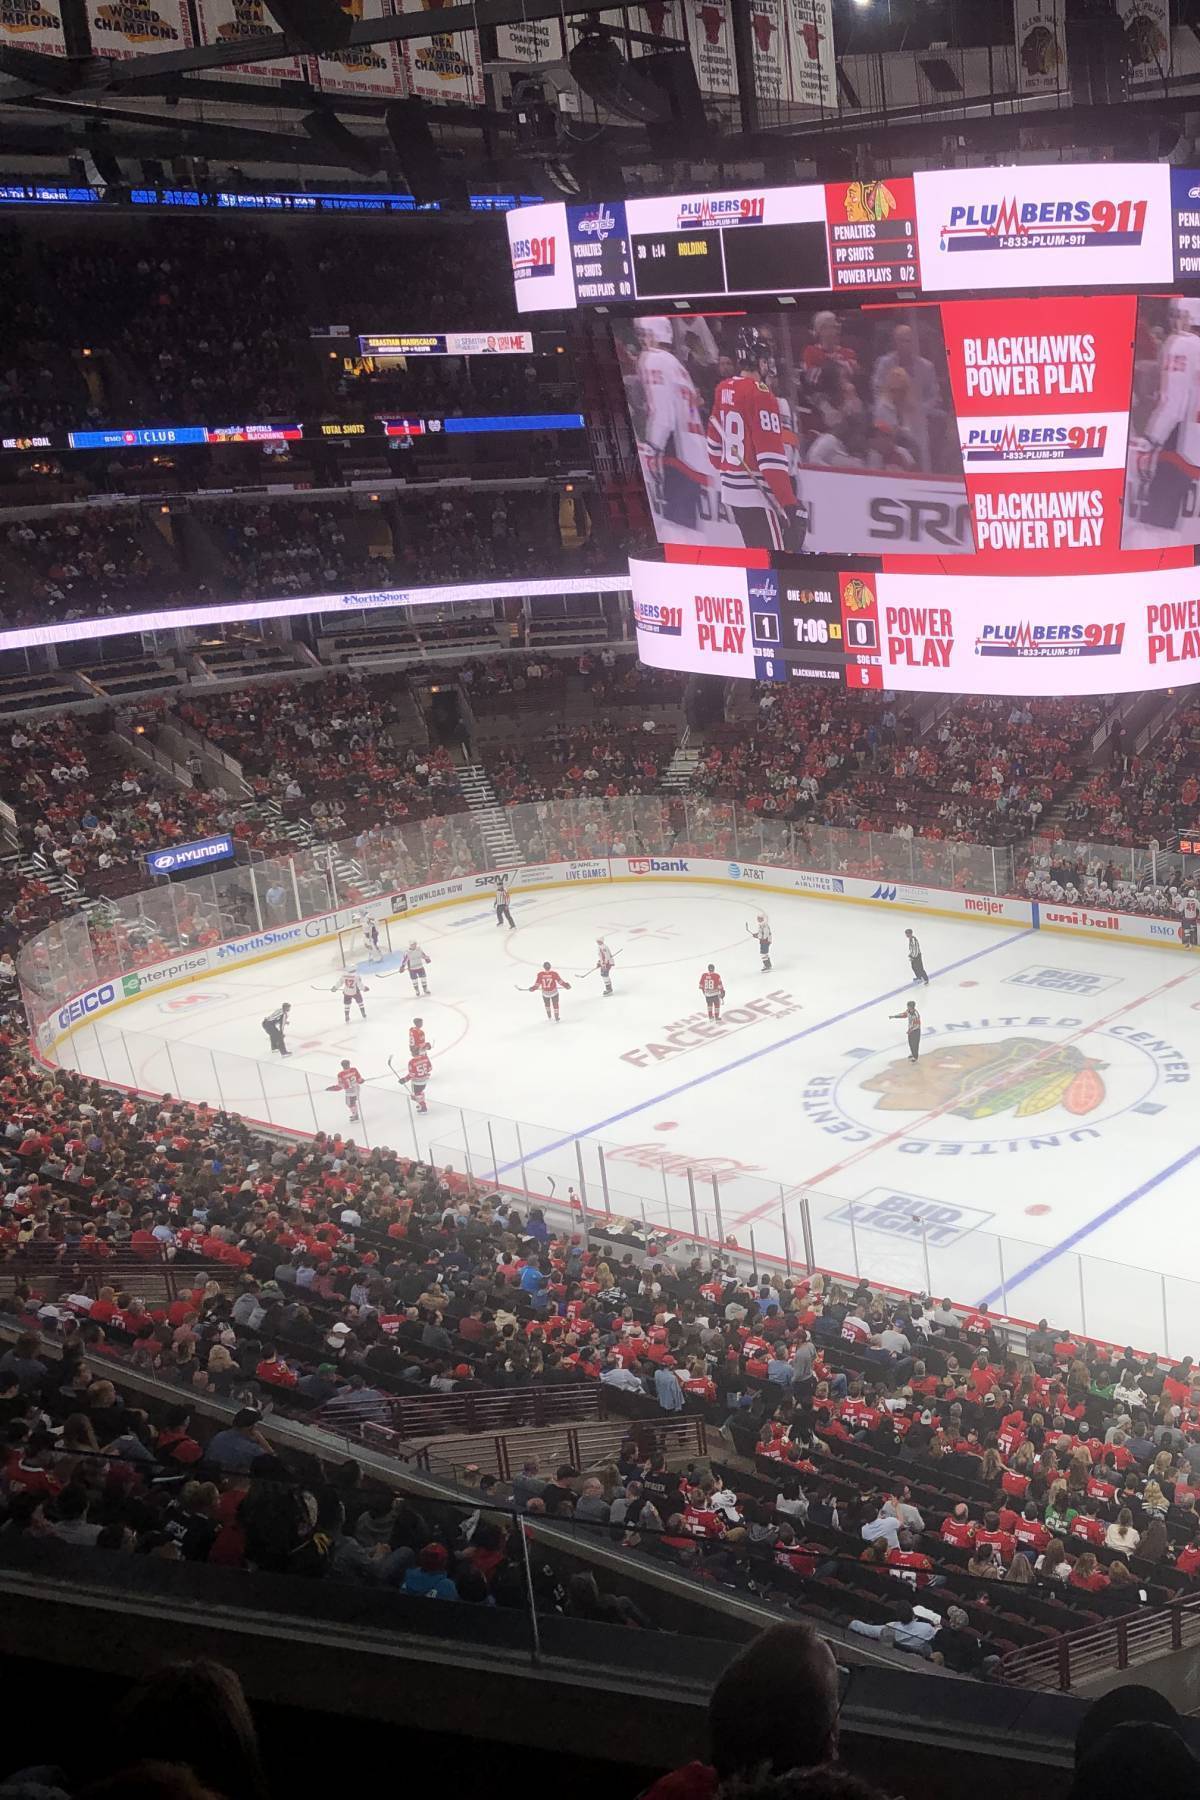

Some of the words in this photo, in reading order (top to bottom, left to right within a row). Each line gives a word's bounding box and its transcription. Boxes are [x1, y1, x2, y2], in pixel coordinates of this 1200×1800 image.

[94, 18, 179, 41] CHAMPIONS
[740, 197, 765, 217] 911
[949, 196, 1092, 235] PLUMBERS
[1091, 199, 1148, 232] 911
[834, 224, 876, 240] PENALTIES
[905, 221, 911, 236] 0
[531, 236, 555, 266] 911
[574, 244, 602, 257] PENALTIES
[621, 242, 626, 254] 2
[678, 241, 707, 256] HOLDING
[998, 235, 1086, 249] 1-833-PLUM-911
[1179, 236, 1190, 249] PP
[836, 248, 847, 262] PP
[848, 247, 874, 261] SHOTS
[907, 244, 913, 258] 2
[576, 266, 583, 277] PP
[584, 264, 602, 277] SHOTS
[623, 263, 628, 275] 0
[838, 269, 867, 284] POWER
[868, 267, 891, 282] PLAYS
[900, 267, 914, 281] 0/2
[578, 284, 597, 297] POWER
[597, 283, 615, 296] PLAYS
[964, 335, 1096, 366] BLACKHAWKS
[966, 363, 1041, 397] POWER
[1044, 363, 1096, 394] PLAY
[322, 425, 342, 434] TOTAL
[343, 424, 365, 434] SHOTS
[759, 410, 782, 433] 88
[2, 439, 16, 448] ONE
[32, 438, 51, 447] GOAL
[144, 431, 176, 442] CLUB
[968, 424, 1068, 450] PLUMBERS
[1068, 425, 1108, 448] 911
[1002, 450, 1065, 460] 1-833-PLUM-911
[975, 490, 1104, 521] BLACKHAWKS
[977, 519, 1049, 550] POWER
[1053, 518, 1104, 546] PLAY
[350, 593, 409, 604] NorthShore
[787, 590, 800, 602] ONE
[815, 591, 832, 603] GOAL
[660, 606, 682, 627] 911
[695, 596, 745, 625] POWER
[762, 617, 770, 638] 1
[793, 618, 828, 643] 7:06
[886, 607, 953, 637] POWER
[698, 624, 745, 654] PLAY
[856, 622, 867, 644] 0
[982, 621, 1083, 647] PLUMBERS
[1084, 623, 1125, 646] 911
[888, 637, 955, 667] PLAY
[1017, 648, 1080, 657] 1-833-PLUM-911
[765, 661, 773, 676] 6
[792, 668, 840, 679] BLACKHAWKS.COM
[861, 669, 869, 684] 5
[176, 842, 228, 864] HYUNDAI
[475, 874, 508, 887] SRM
[566, 869, 580, 880] LIVE
[582, 868, 607, 879] GAMES
[743, 868, 765, 881] AT&T
[801, 875, 830, 884] UNITED
[410, 889, 446, 903] DOWNLOAD
[448, 884, 462, 894] NOW
[795, 881, 831, 890] AIRLINES
[965, 897, 1004, 915] meijer
[1046, 912, 1120, 930] uni-ball
[1150, 925, 1174, 937] BMO
[226, 928, 301, 956] NorthShore
[125, 957, 206, 990] enterprise
[1036, 968, 1101, 985] BUD
[1010, 974, 1101, 994] LIGHT
[58, 984, 114, 1029] GEICO
[662, 1012, 709, 1032] NHL
[919, 1016, 1083, 1036] UNITED
[1109, 1025, 1192, 1085] CENTER
[800, 1075, 872, 1143] CENTER
[897, 1127, 1102, 1156] UNITED
[876, 1195, 964, 1224] BUD
[840, 1205, 961, 1242] LIGHT
